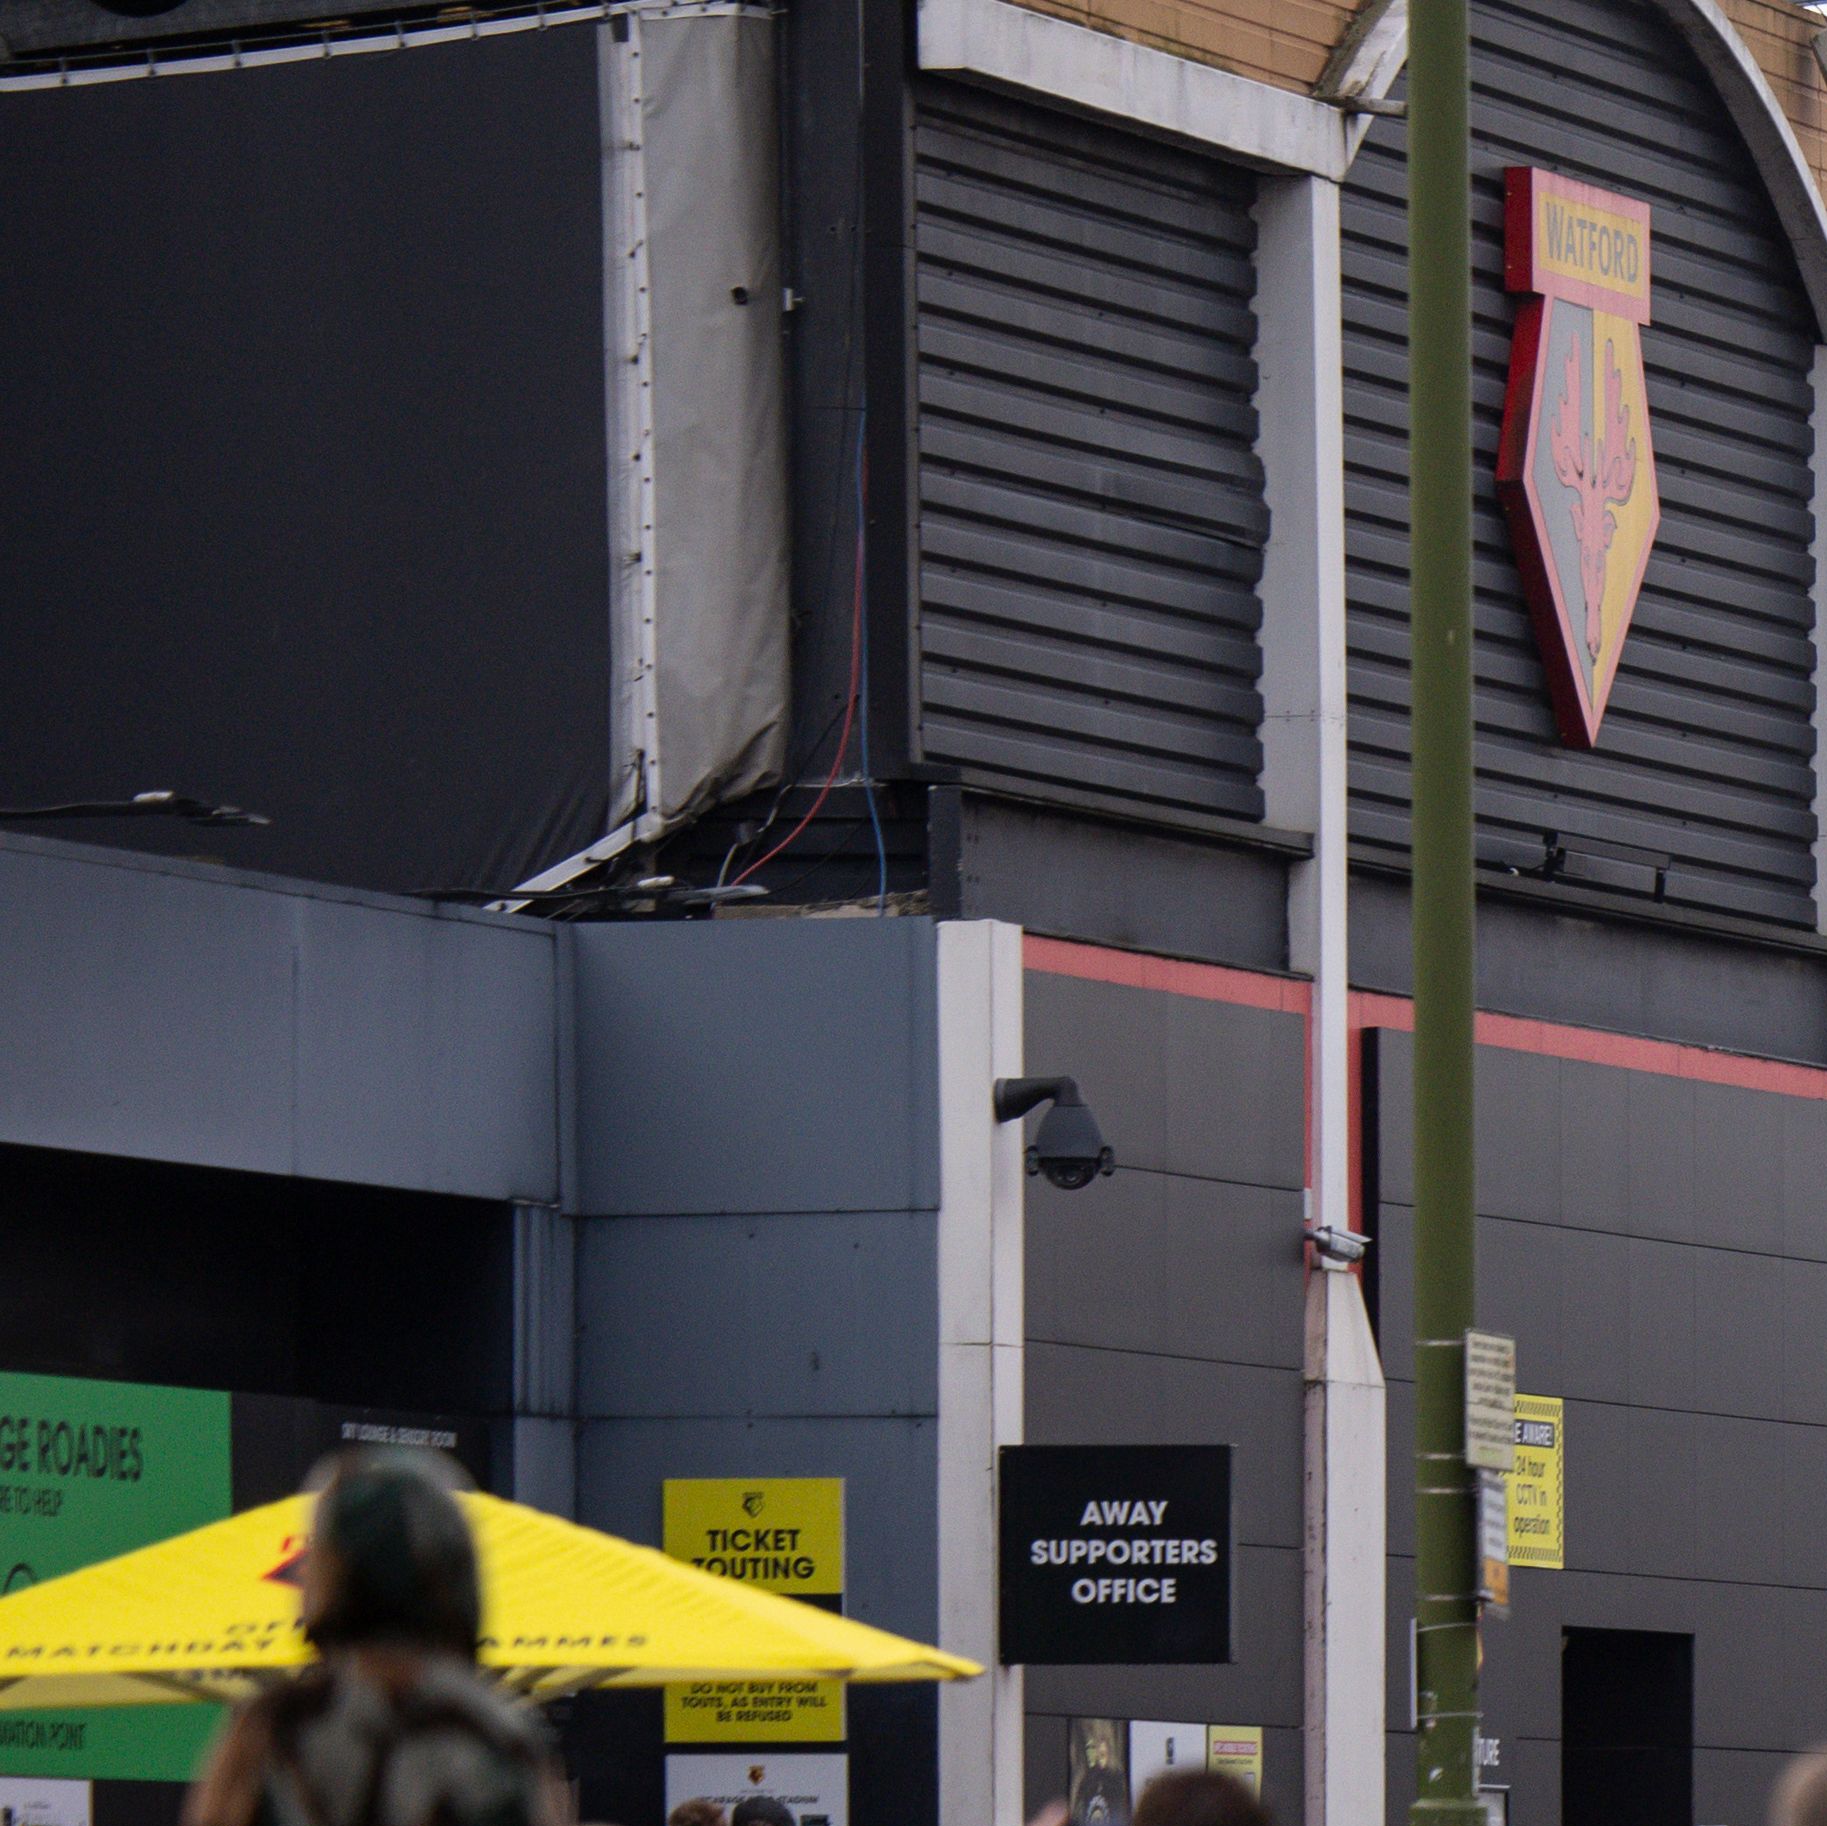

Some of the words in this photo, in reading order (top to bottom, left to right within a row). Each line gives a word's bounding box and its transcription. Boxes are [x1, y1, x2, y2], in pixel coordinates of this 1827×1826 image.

[1545, 201, 1639, 284] WATFORD
[37, 1420, 144, 1483] ROADIES
[1080, 1501, 1168, 1526] AWAY
[706, 1529, 801, 1551] TICKET
[1030, 1540, 1218, 1565] SUPPORTERS
[692, 1557, 815, 1579] TOUTING
[1071, 1578, 1177, 1604] OFFICE
[690, 1683, 712, 1694] DO
[716, 1683, 742, 1694] NOT
[748, 1683, 773, 1693] BUY
[778, 1682, 817, 1692] FROM
[730, 1697, 748, 1708] AS
[752, 1697, 792, 1708] ENTRY
[797, 1697, 828, 1708] WILL
[716, 1711, 732, 1722] BE
[736, 1711, 792, 1722] REFUSED
